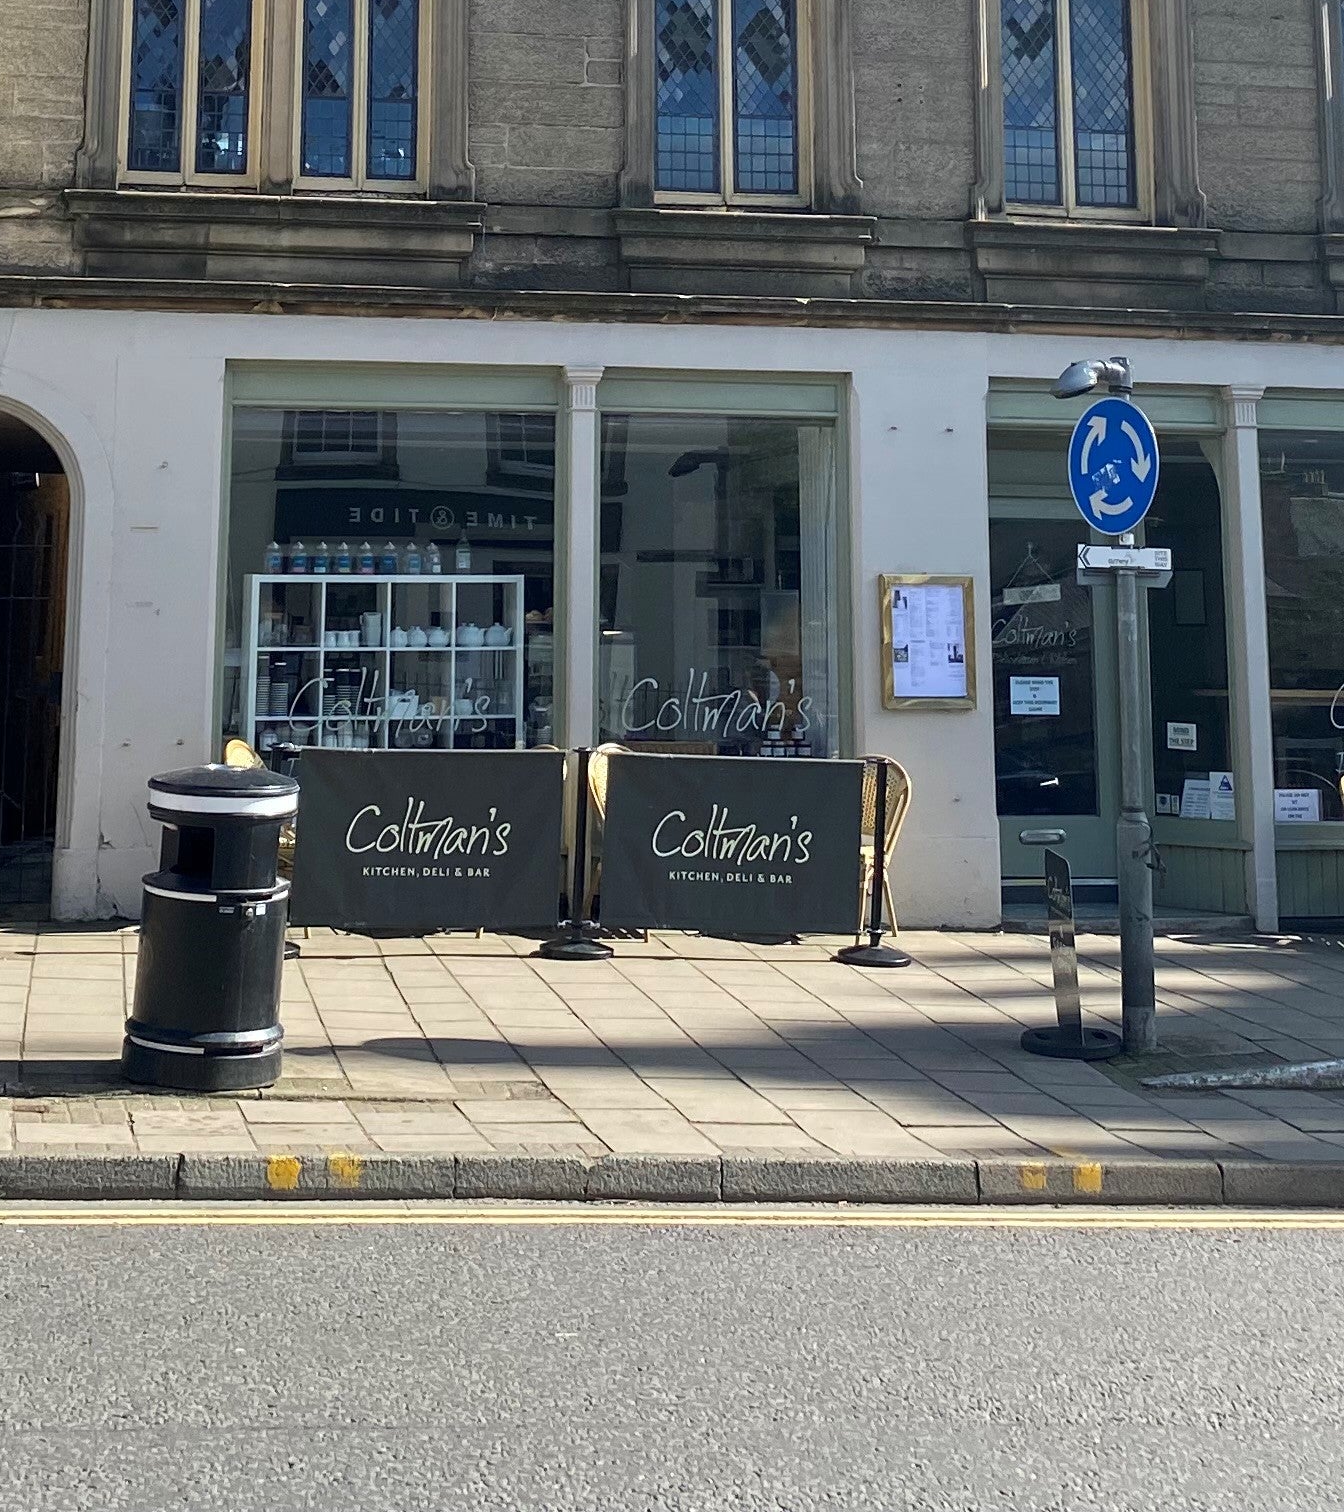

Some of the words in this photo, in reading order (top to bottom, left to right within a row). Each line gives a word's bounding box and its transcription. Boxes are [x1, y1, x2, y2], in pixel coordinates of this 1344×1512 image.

[991, 614, 1077, 649] Coltman's
[288, 666, 491, 739] Coltman's
[621, 667, 813, 738] Coltman's
[345, 796, 512, 860] Coltman's
[652, 803, 813, 866] Coltman's
[362, 866, 420, 878] KITCHEN,
[422, 866, 450, 878] DELI
[454, 866, 463, 877] &
[467, 866, 491, 878] BAR
[669, 871, 724, 884] KITCHEN,
[726, 872, 753, 883] DELI
[757, 873, 766, 883] &
[770, 874, 793, 884] BAR
